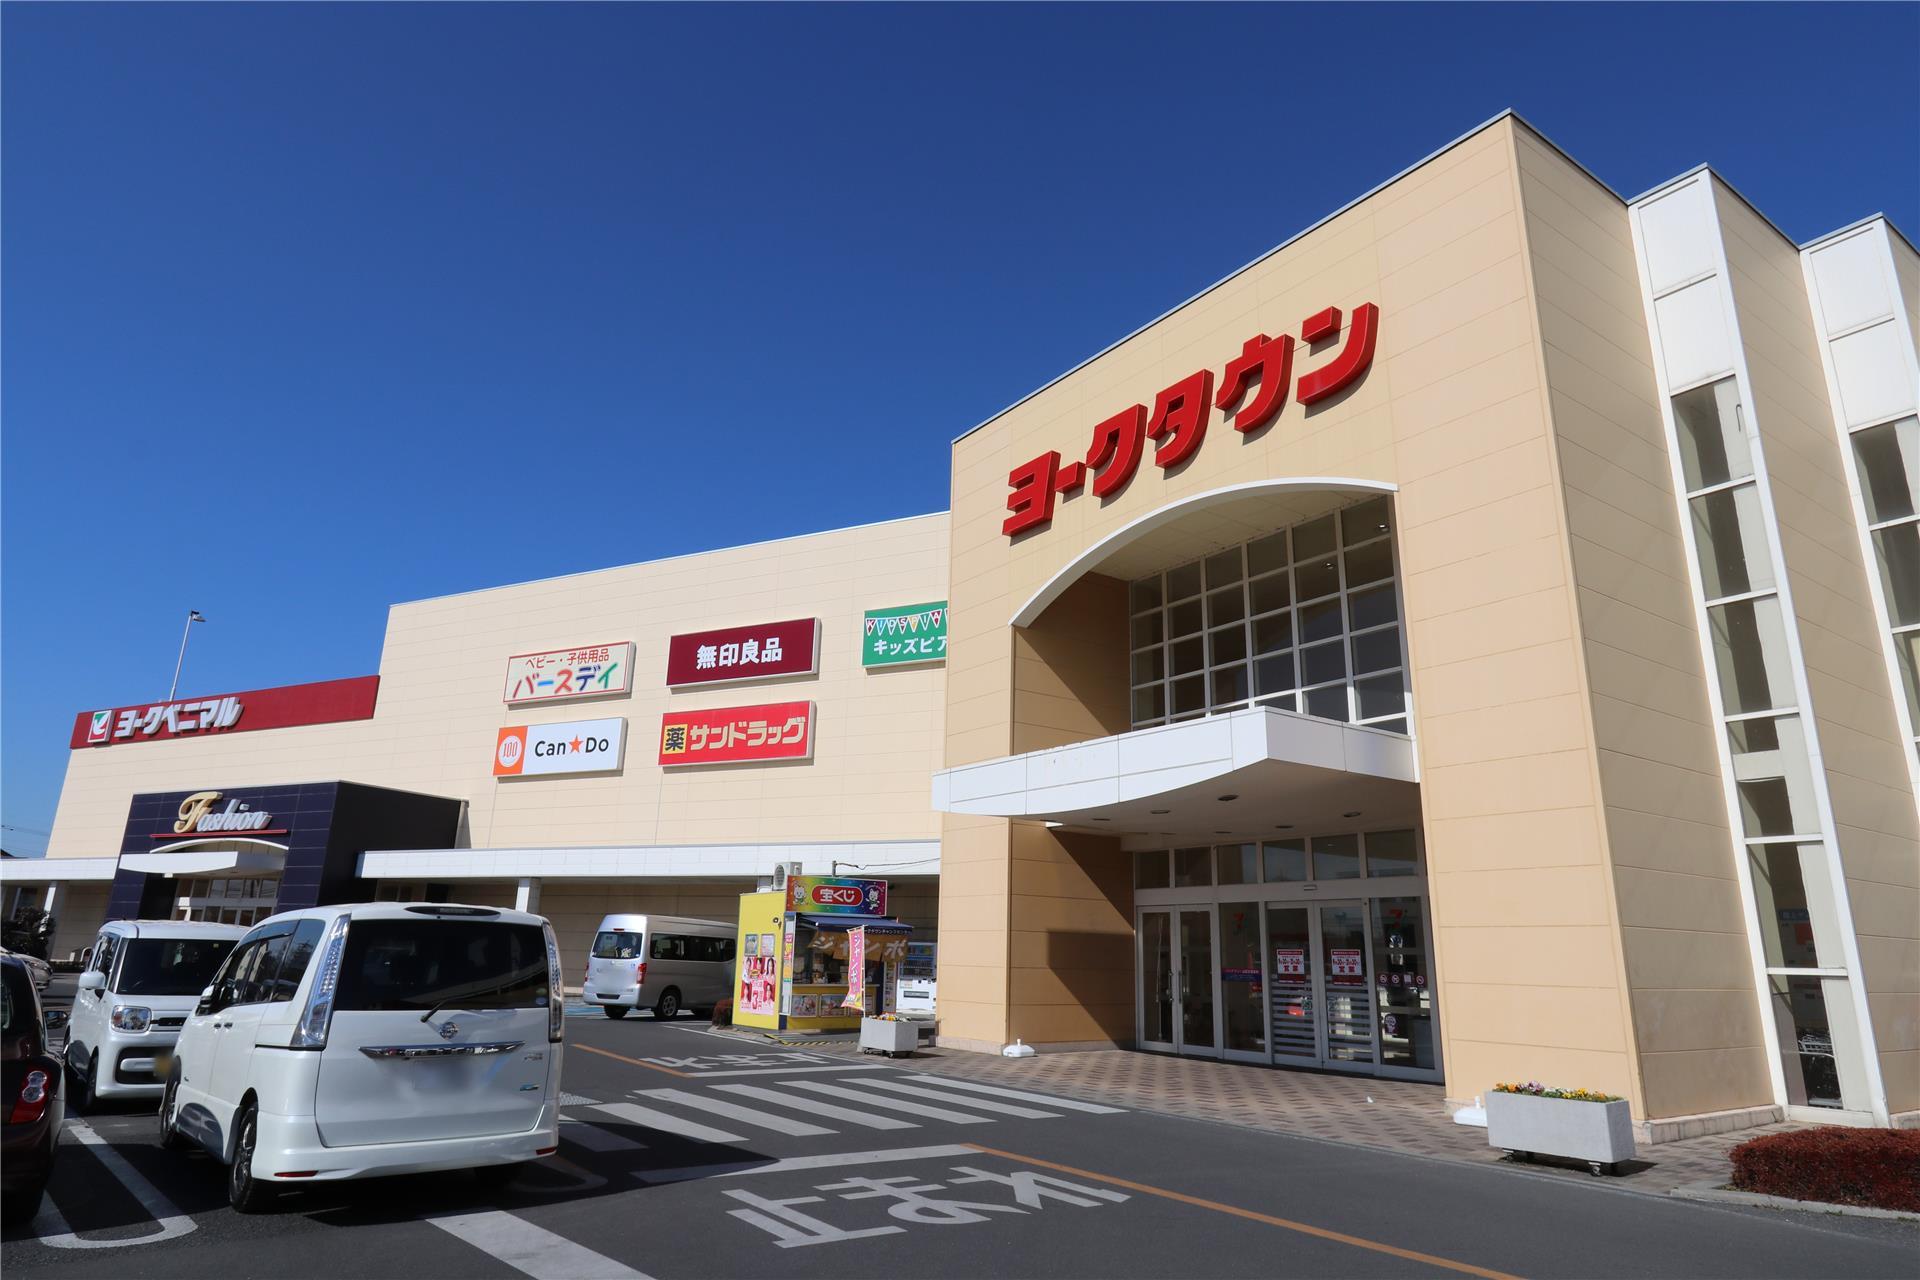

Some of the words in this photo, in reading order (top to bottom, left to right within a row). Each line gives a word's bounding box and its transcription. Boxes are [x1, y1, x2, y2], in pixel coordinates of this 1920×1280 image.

[1002, 302, 1379, 537] ヨークタウン
[526, 648, 609, 668] ベビー・子供用品
[696, 637, 782, 669] 無印良品
[513, 662, 617, 698] バースデイ
[114, 697, 242, 738] ヨークベニマル
[665, 727, 684, 751] 薬
[690, 716, 805, 750] サンドラッグ
[503, 742, 518, 757] 100
[535, 740, 566, 757] Can
[586, 737, 609, 753] Do
[174, 791, 272, 833] Fashion
[820, 888, 855, 903] 宝くじ
[638, 1052, 830, 1068] 止まれ
[721, 1166, 1131, 1248] 止まれ
